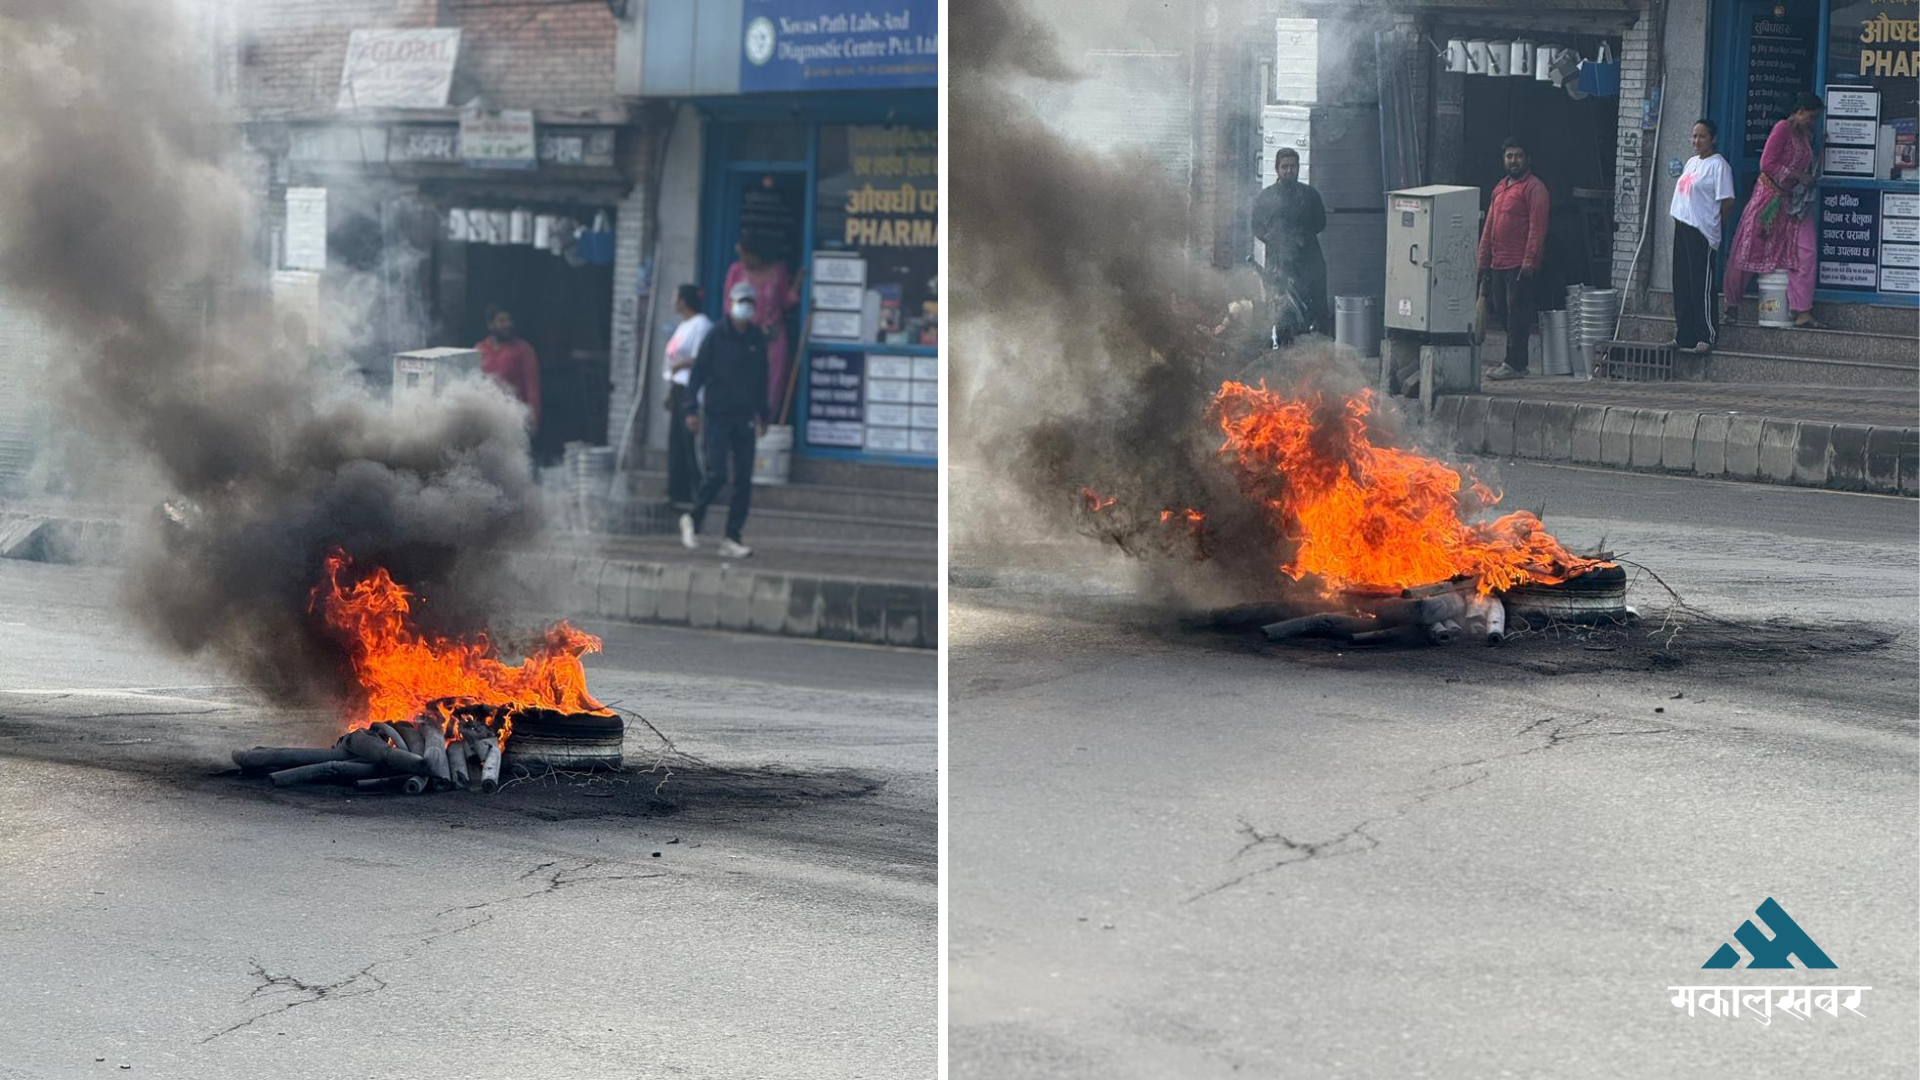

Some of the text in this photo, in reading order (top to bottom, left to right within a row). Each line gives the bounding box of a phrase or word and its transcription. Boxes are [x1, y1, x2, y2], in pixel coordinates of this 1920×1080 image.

[819, 13, 848, 33] Path
[850, 11, 881, 32] Labs
[778, 39, 842, 64] Diagnostic
[843, 36, 886, 58] Centre
